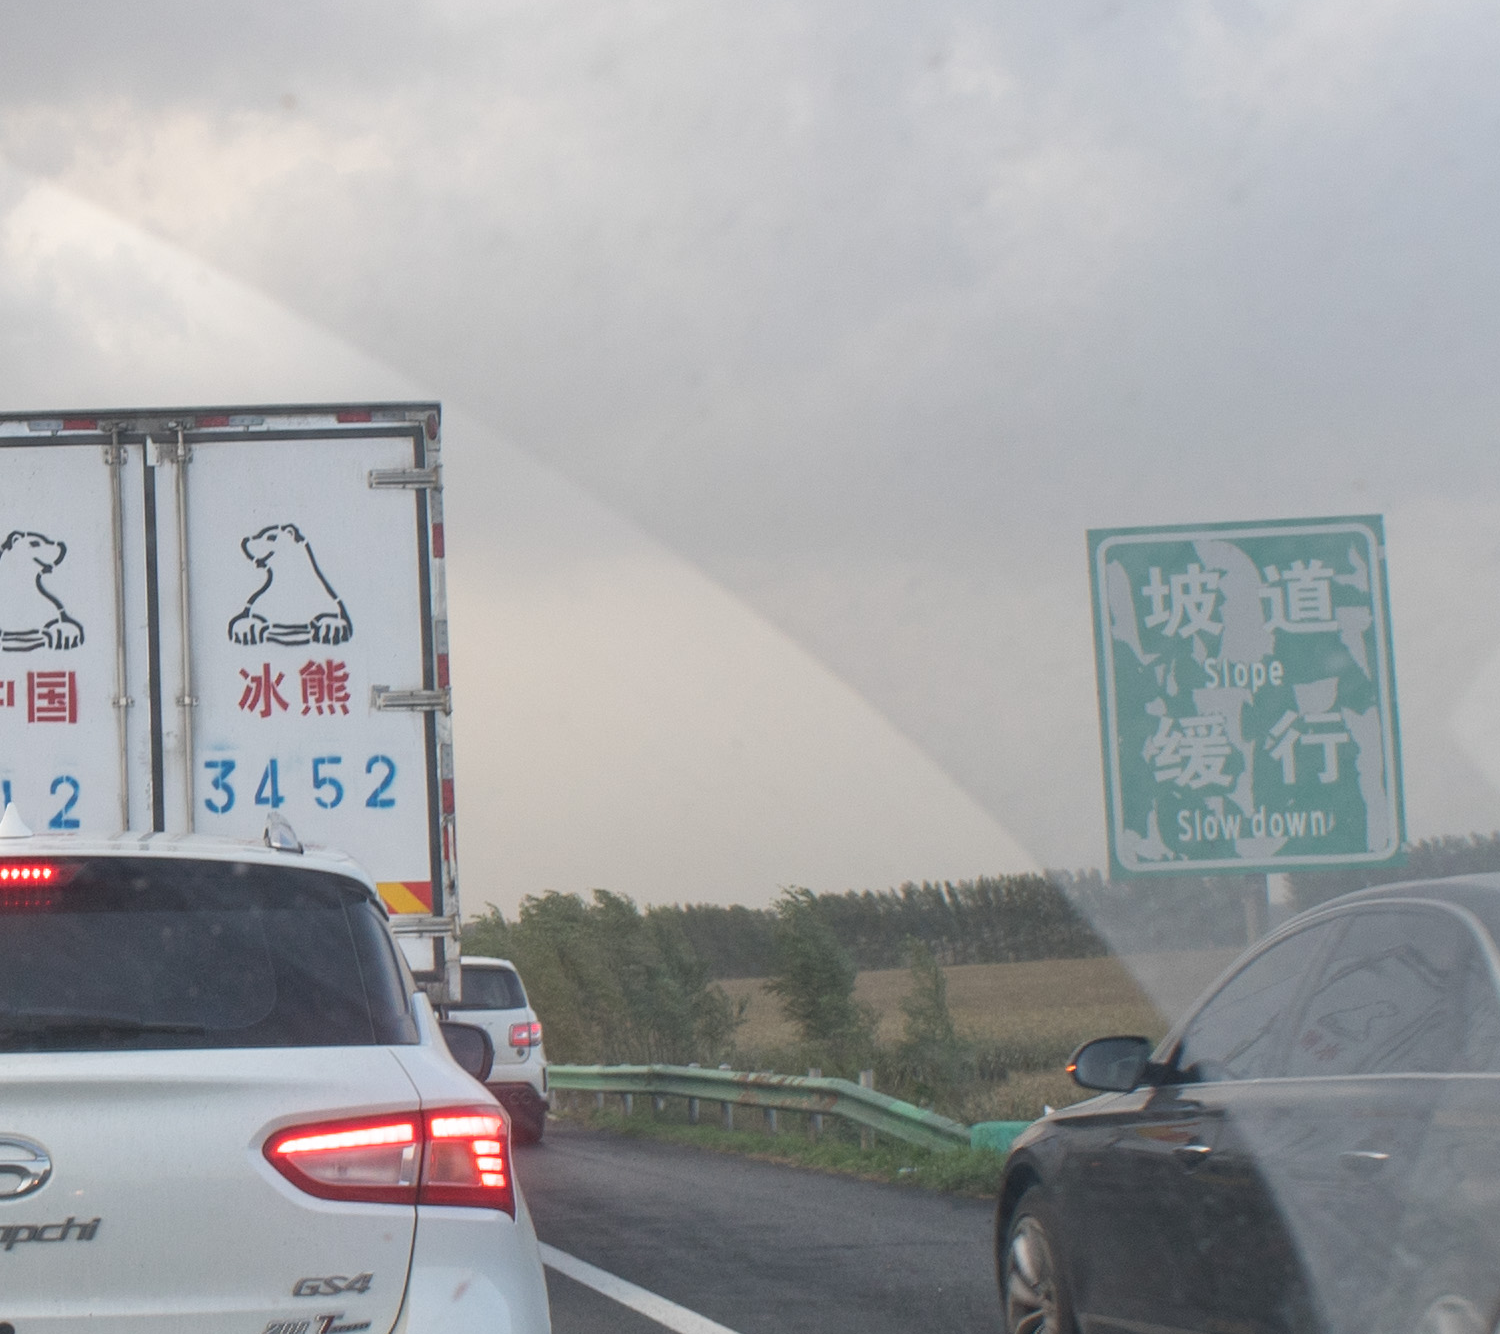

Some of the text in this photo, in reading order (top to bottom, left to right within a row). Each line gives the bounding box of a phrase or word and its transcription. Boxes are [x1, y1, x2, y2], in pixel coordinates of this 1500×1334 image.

[1142, 558, 1340, 639] 坡道
[237, 658, 352, 719] 冰熊
[1204, 656, 1284, 693] Slope
[1152, 710, 1350, 789] 缓行
[1177, 804, 1327, 842] Slow down
[292, 1272, 374, 1298] GS4
